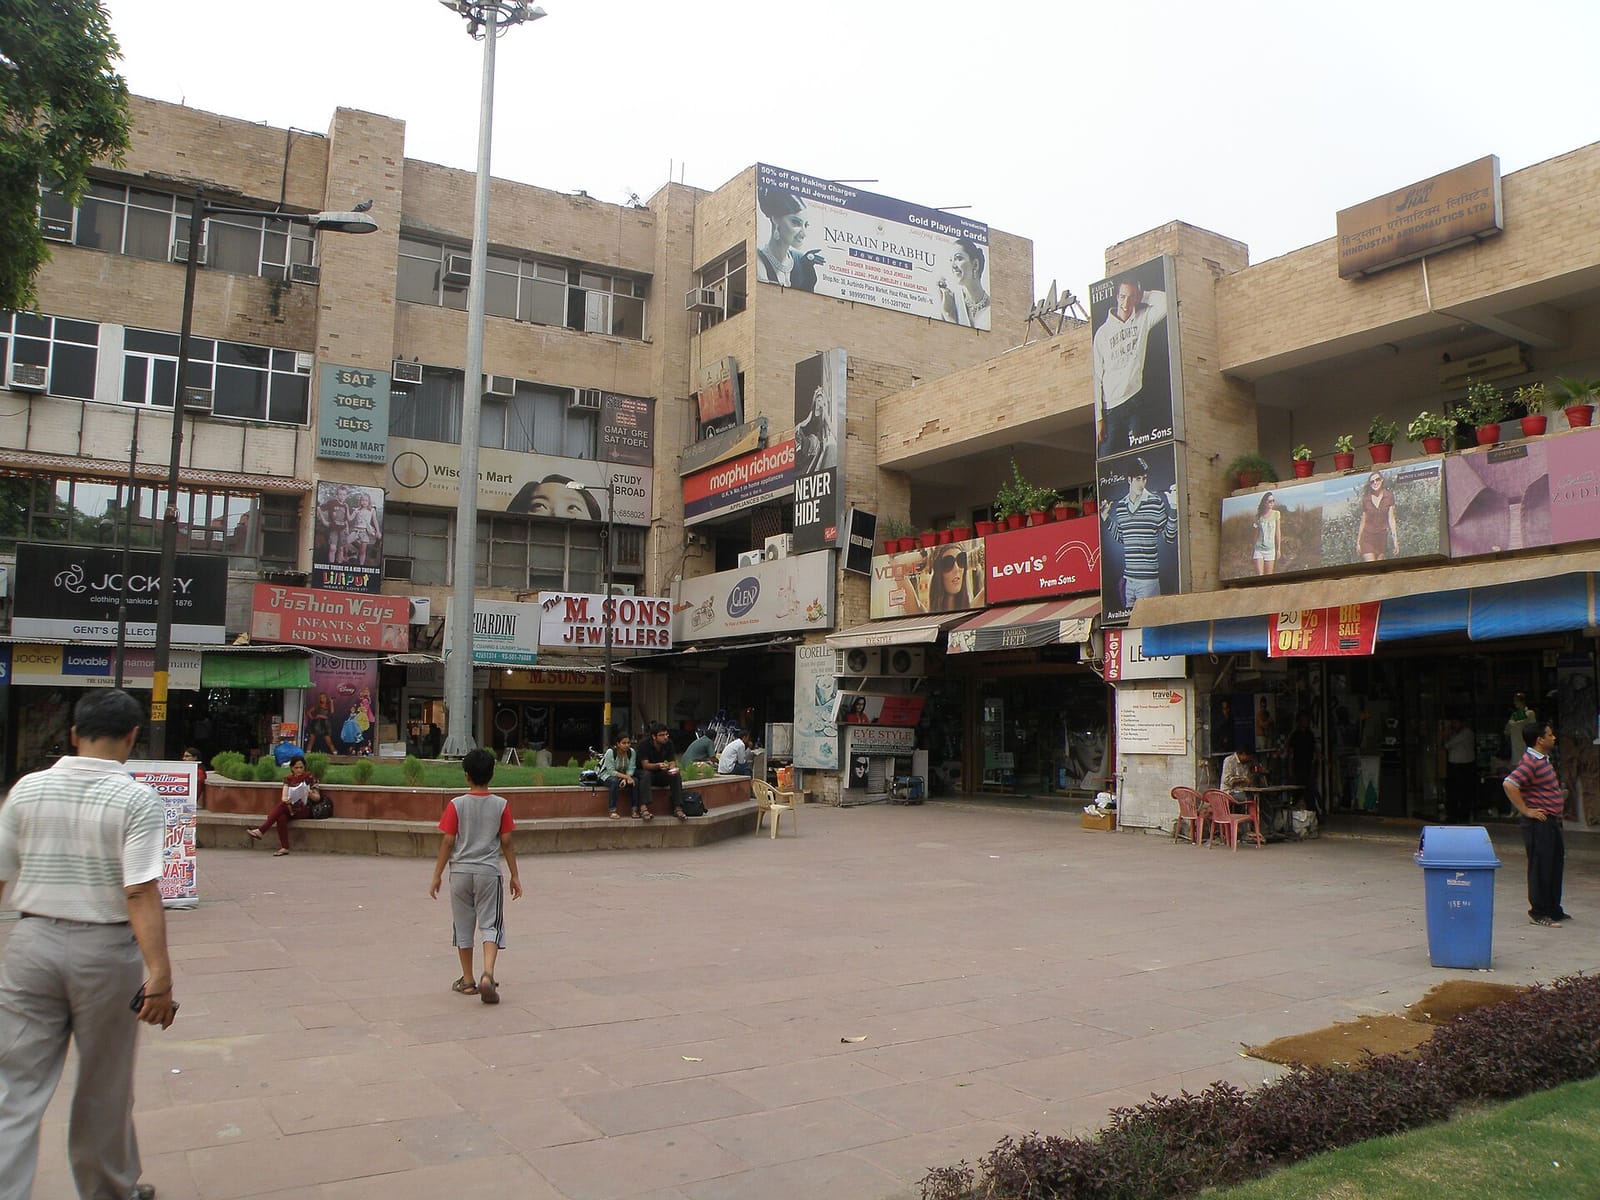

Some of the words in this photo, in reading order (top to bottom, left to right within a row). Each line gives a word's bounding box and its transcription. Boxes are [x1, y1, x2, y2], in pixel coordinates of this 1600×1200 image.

[761, 166, 777, 177] 50%
[779, 171, 789, 179] off
[801, 177, 827, 191] Making
[828, 184, 857, 198] Charges
[761, 177, 777, 186] 10%
[779, 181, 789, 189] off
[801, 186, 811, 195] All
[812, 190, 847, 206] Jewellery
[908, 214, 929, 227] Gold
[930, 219, 962, 238] Playing
[963, 229, 988, 243] Cards
[1342, 233, 1395, 258] HINDUSTAN
[1396, 209, 1465, 240] AERONAUTICS
[1467, 202, 1488, 216] LTD
[824, 226, 879, 250] NARAIN
[882, 240, 936, 268] PRABHU
[853, 249, 910, 270] Jewellers
[342, 372, 370, 386] SAT
[337, 396, 373, 408] TOEFL
[338, 418, 370, 430] IELTS
[604, 425, 628, 436] GMAT
[631, 429, 649, 439] GRE
[320, 437, 358, 450] WISDOM
[360, 441, 385, 453] MART
[604, 434, 620, 444] SAT
[622, 437, 649, 448] TOEFL
[1129, 434, 1150, 447] Prem
[1150, 427, 1173, 441] Sons
[433, 465, 482, 481] Wism
[486, 471, 513, 484] Mart
[709, 462, 749, 492] morphy
[749, 445, 795, 477] richards
[613, 473, 642, 486] STUDY
[760, 473, 784, 485] appliances
[795, 471, 831, 503] NEVER
[615, 485, 646, 498] BROAD
[729, 496, 760, 511] APPLIANCES
[795, 499, 821, 527] HIDE
[992, 555, 1045, 578] Levi's
[1040, 577, 1058, 589] Prem
[1057, 574, 1077, 586] Sons
[90, 595, 120, 605] clothing
[175, 599, 193, 607] 1876
[270, 586, 345, 615] Fashion
[346, 598, 395, 625] Ways
[542, 594, 561, 613] The
[563, 596, 595, 623] M.
[601, 598, 671, 626] SONS
[1339, 605, 1361, 624] BIG
[73, 625, 109, 636] GENT'S
[297, 616, 354, 632] INFANTS
[356, 622, 368, 633] &
[473, 612, 517, 636] UARDINI
[1338, 622, 1361, 636] SALE
[291, 630, 329, 642] KID'S
[331, 633, 372, 646] WEAR
[1001, 635, 1027, 647] HEIT
[1278, 629, 1313, 651] OFF
[14, 653, 59, 664] JOCKEY
[67, 655, 109, 667] Lovable
[799, 646, 832, 660] CORELLE
[1152, 690, 1172, 698] travel
[853, 728, 875, 738] EYE
[878, 729, 913, 741] STYLE
[144, 773, 178, 783] Dollar
[165, 824, 185, 849] nly
[162, 862, 189, 878] VAT
